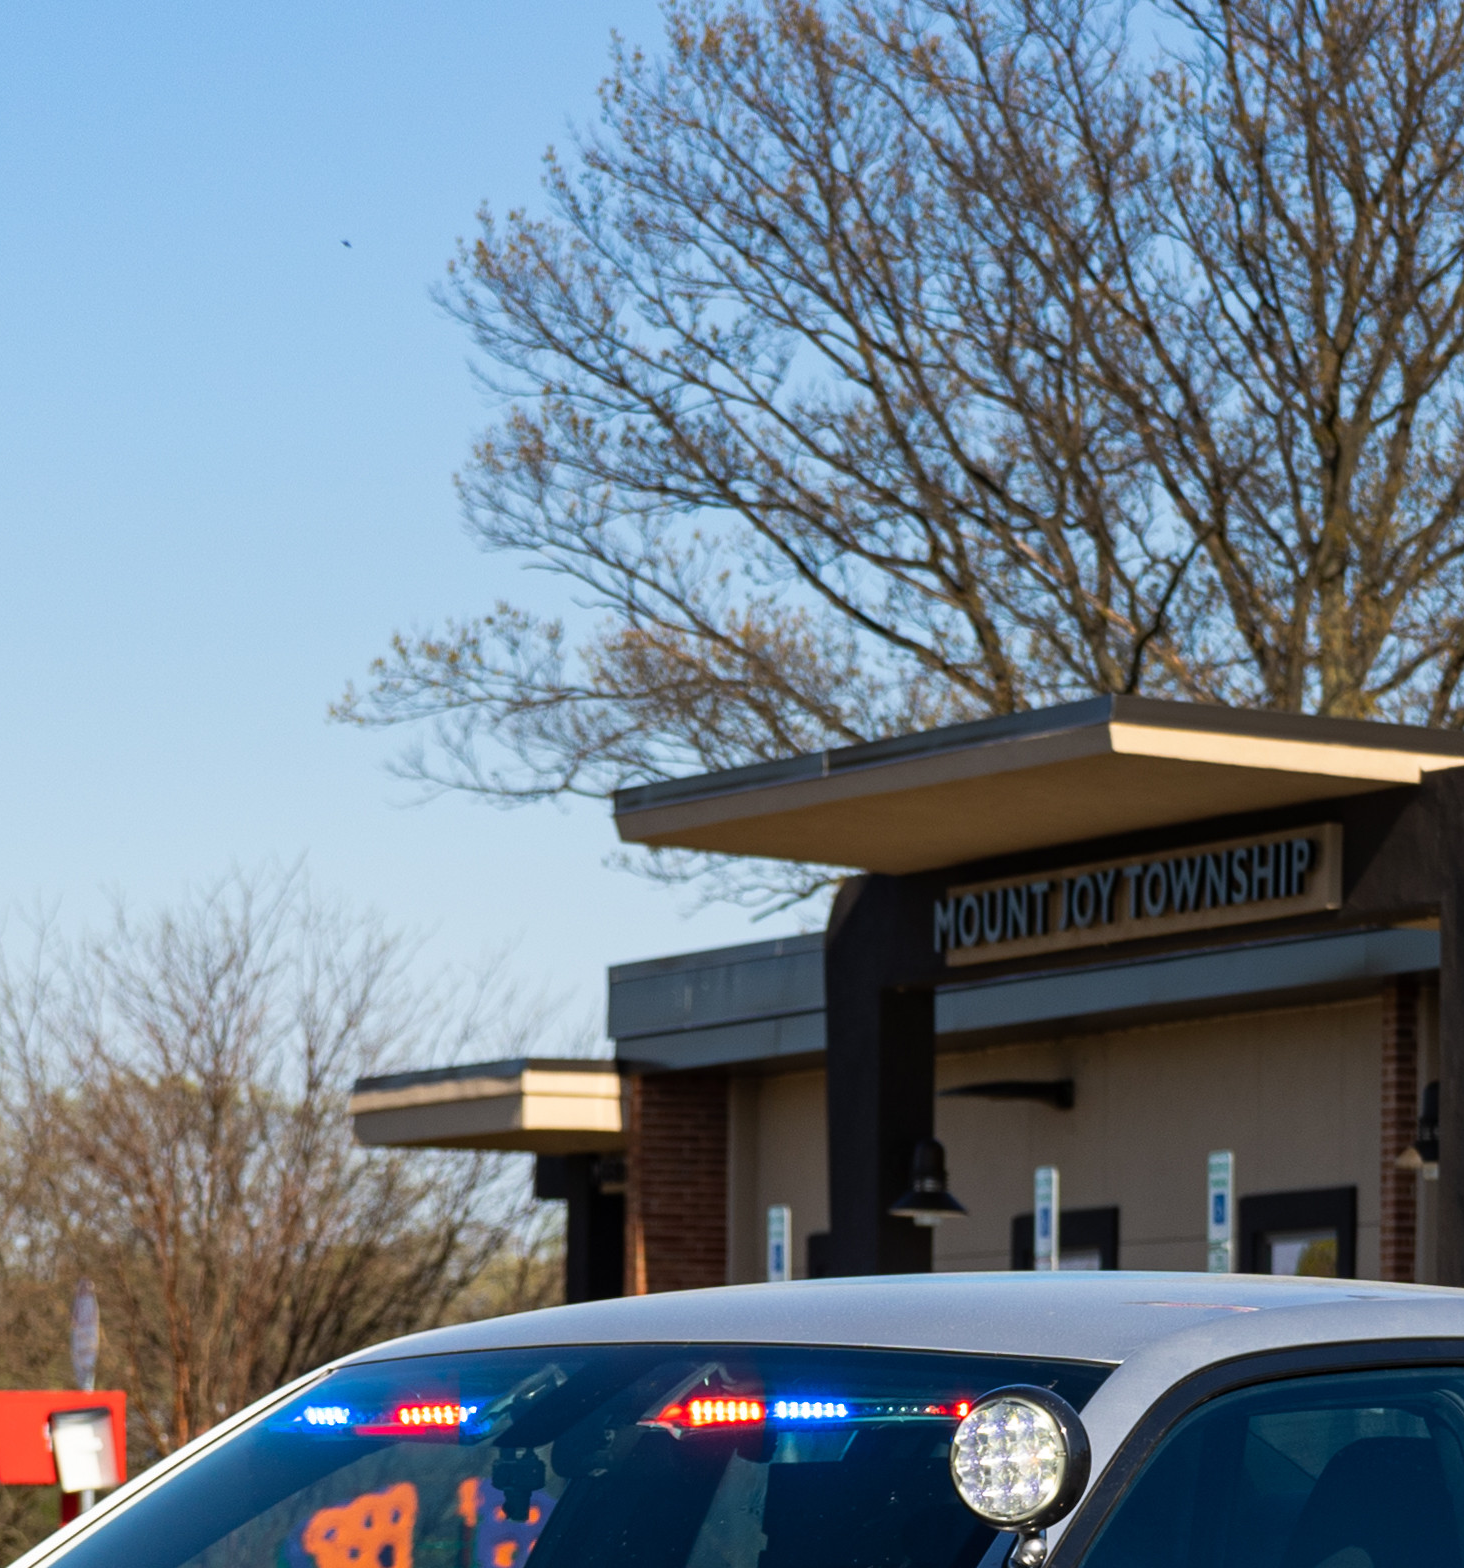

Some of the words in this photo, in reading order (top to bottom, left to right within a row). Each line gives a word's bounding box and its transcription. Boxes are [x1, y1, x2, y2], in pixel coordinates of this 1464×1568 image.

[934, 881, 1050, 953] MOUNT
[1058, 868, 1118, 931] JOY
[1123, 838, 1311, 918] TOWNSHIP
